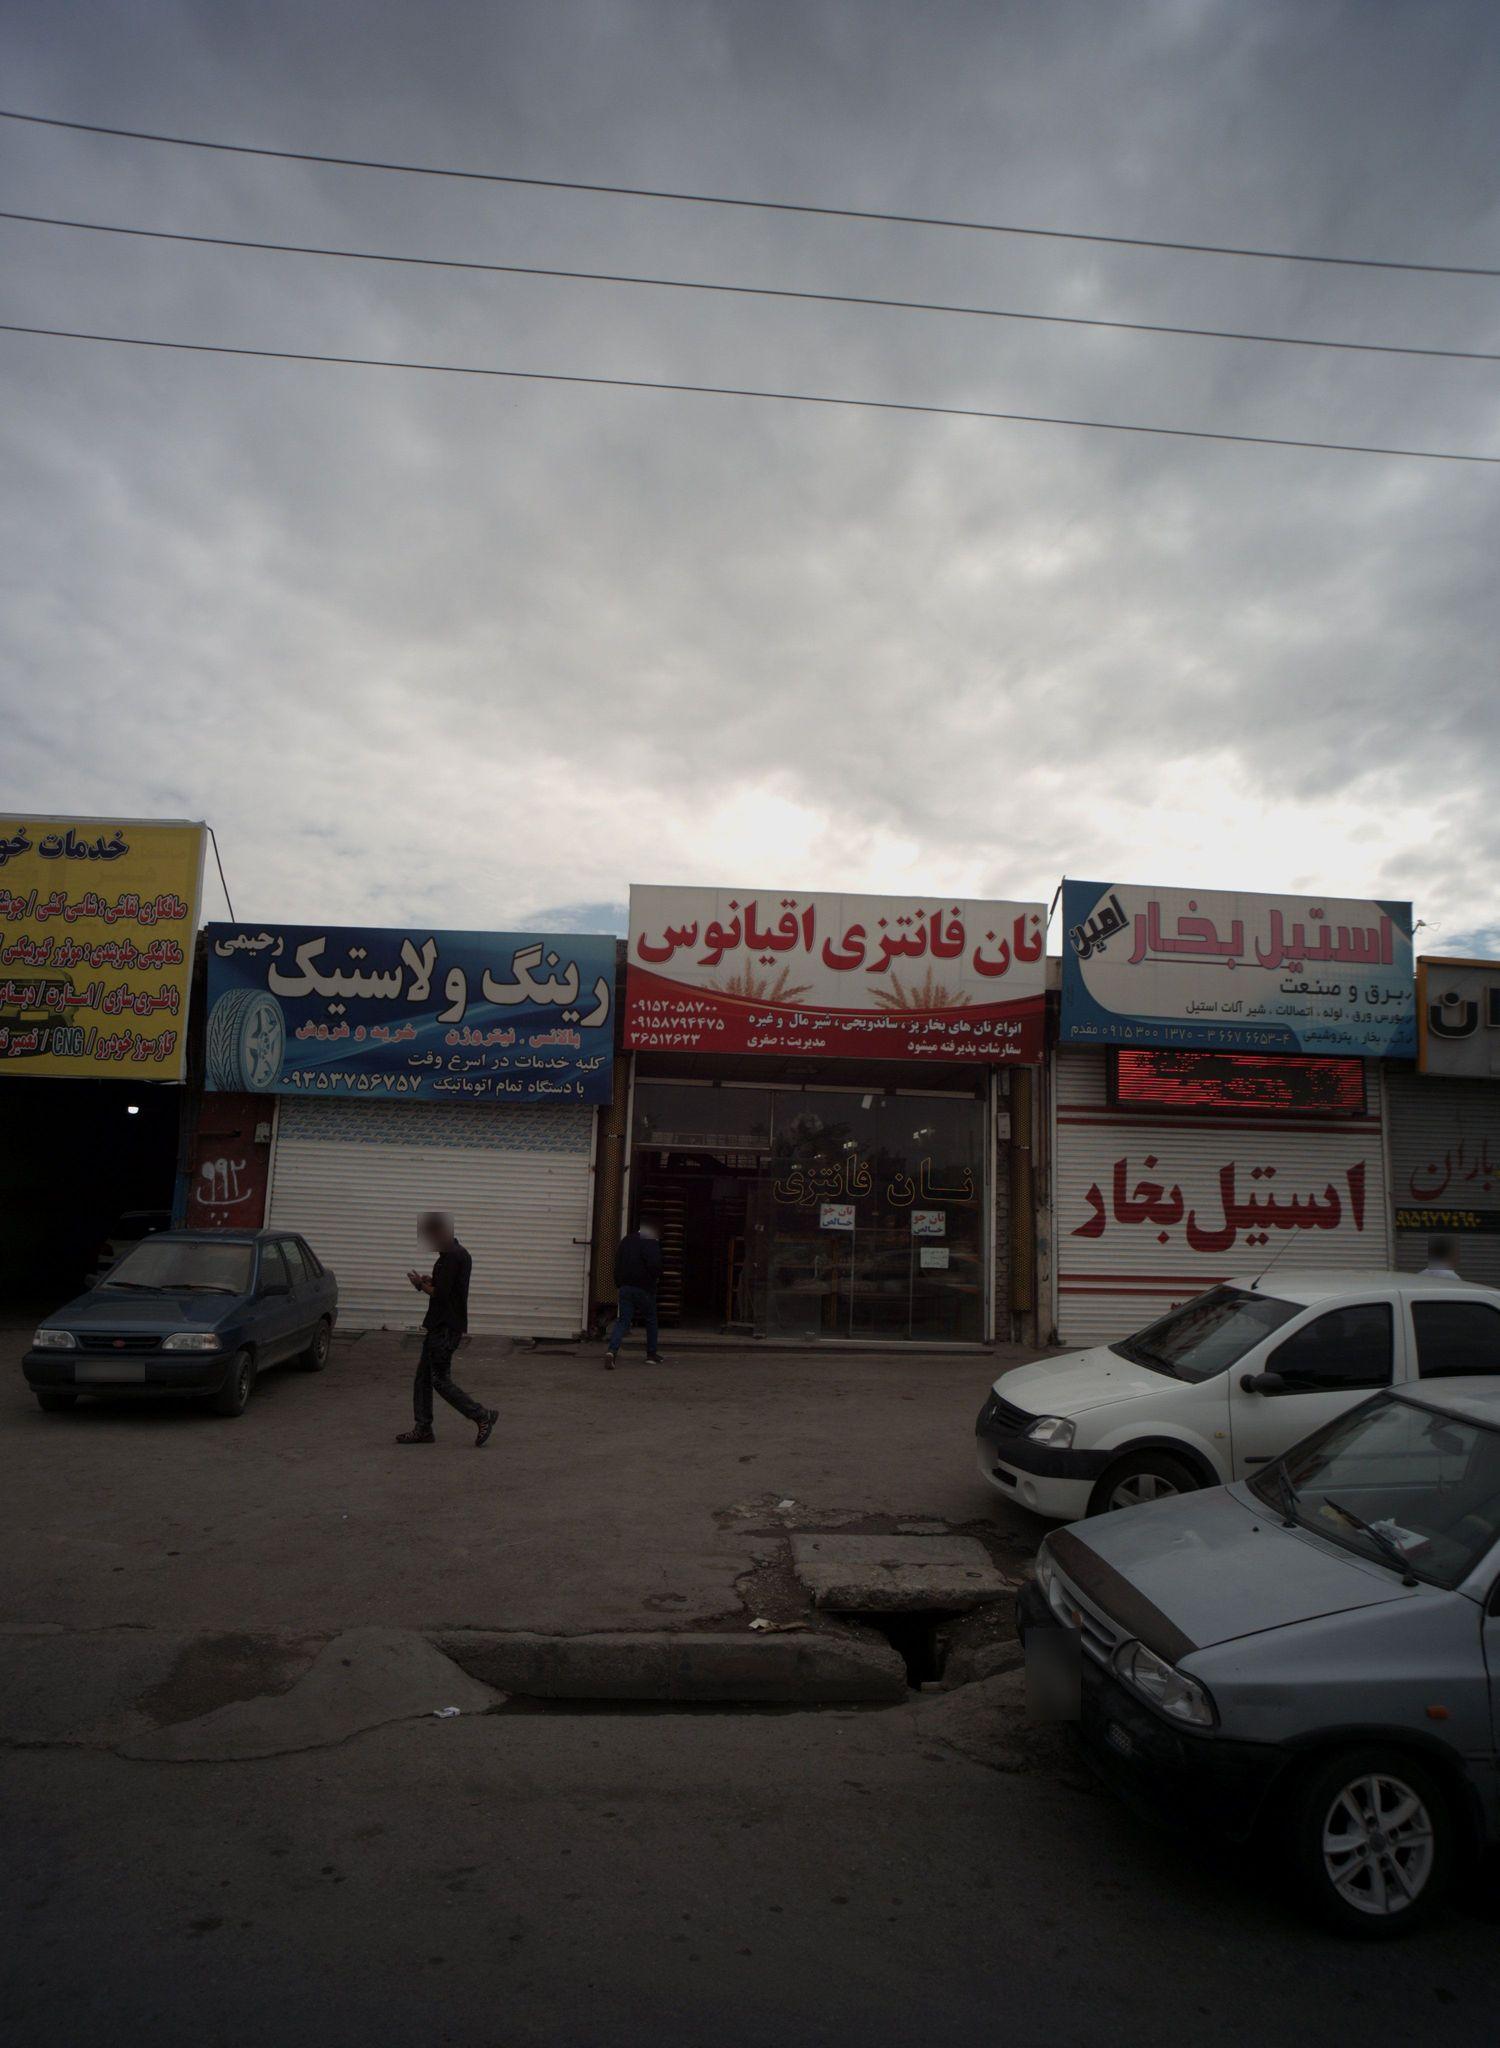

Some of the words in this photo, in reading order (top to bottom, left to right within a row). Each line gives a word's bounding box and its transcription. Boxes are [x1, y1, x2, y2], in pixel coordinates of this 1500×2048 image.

[39, 828, 129, 860] خدمات
[36, 892, 68, 922] کشی
[64, 892, 98, 923] شاسی
[104, 894, 140, 924] نقاشی
[636, 899, 815, 966] اقیانوس
[1070, 894, 1130, 959] امین
[1128, 901, 1244, 970] بخار
[214, 931, 284, 957] رحیمی
[821, 905, 966, 973] فانتزی
[973, 912, 1043, 977] نان
[1255, 907, 1393, 973] استیل
[137, 939, 183, 969] مکانیکی
[481, 942, 610, 1027] رینگ
[1280, 978, 1341, 997] صنعت
[103, 983, 135, 1014] سازی
[134, 984, 179, 1015] باطری
[1349, 985, 1358, 1003] و
[1185, 1000, 1217, 1014] استیل
[1221, 1000, 1242, 1013] آلات
[1246, 1004, 1266, 1017] شیر
[1275, 1005, 1313, 1017] اتصالات
[1322, 1007, 1343, 1021] لوله
[748, 1013, 774, 1028] غیره
[776, 1016, 783, 1028] و
[949, 1019, 971, 1035] های
[973, 1021, 992, 1036] نان
[994, 1020, 1022, 1037] انواع
[295, 1019, 351, 1041] فروش
[354, 1025, 367, 1041] و
[370, 1022, 418, 1044] خرید
[445, 1025, 516, 1047] نیتروژن
[528, 1028, 582, 1050] بالانس
[52, 1026, 84, 1056] CNG
[746, 1035, 778, 1048] صفری
[786, 1036, 826, 1049] مدیریت
[907, 1040, 938, 1055] میشود
[939, 1040, 976, 1056] پذیرفته
[978, 1043, 1021, 1057] سفارشات
[408, 1050, 443, 1069] وقت
[448, 1054, 486, 1071] اسرع
[492, 1056, 509, 1071] در
[515, 1055, 569, 1069] خدمات
[575, 1056, 606, 1073] کلیه
[433, 1077, 491, 1096] اتوماتیک
[496, 1078, 522, 1096] تمام
[527, 1080, 572, 1095] دستگاه
[576, 1081, 584, 1098] با
[773, 1153, 872, 1207] فانتزی
[887, 1157, 975, 1207] نان
[1071, 1155, 1185, 1245] بخار
[1186, 1160, 1366, 1252] استیل
[838, 1206, 853, 1217] نان
[913, 1214, 927, 1224] جو
[929, 1212, 944, 1225] نان
